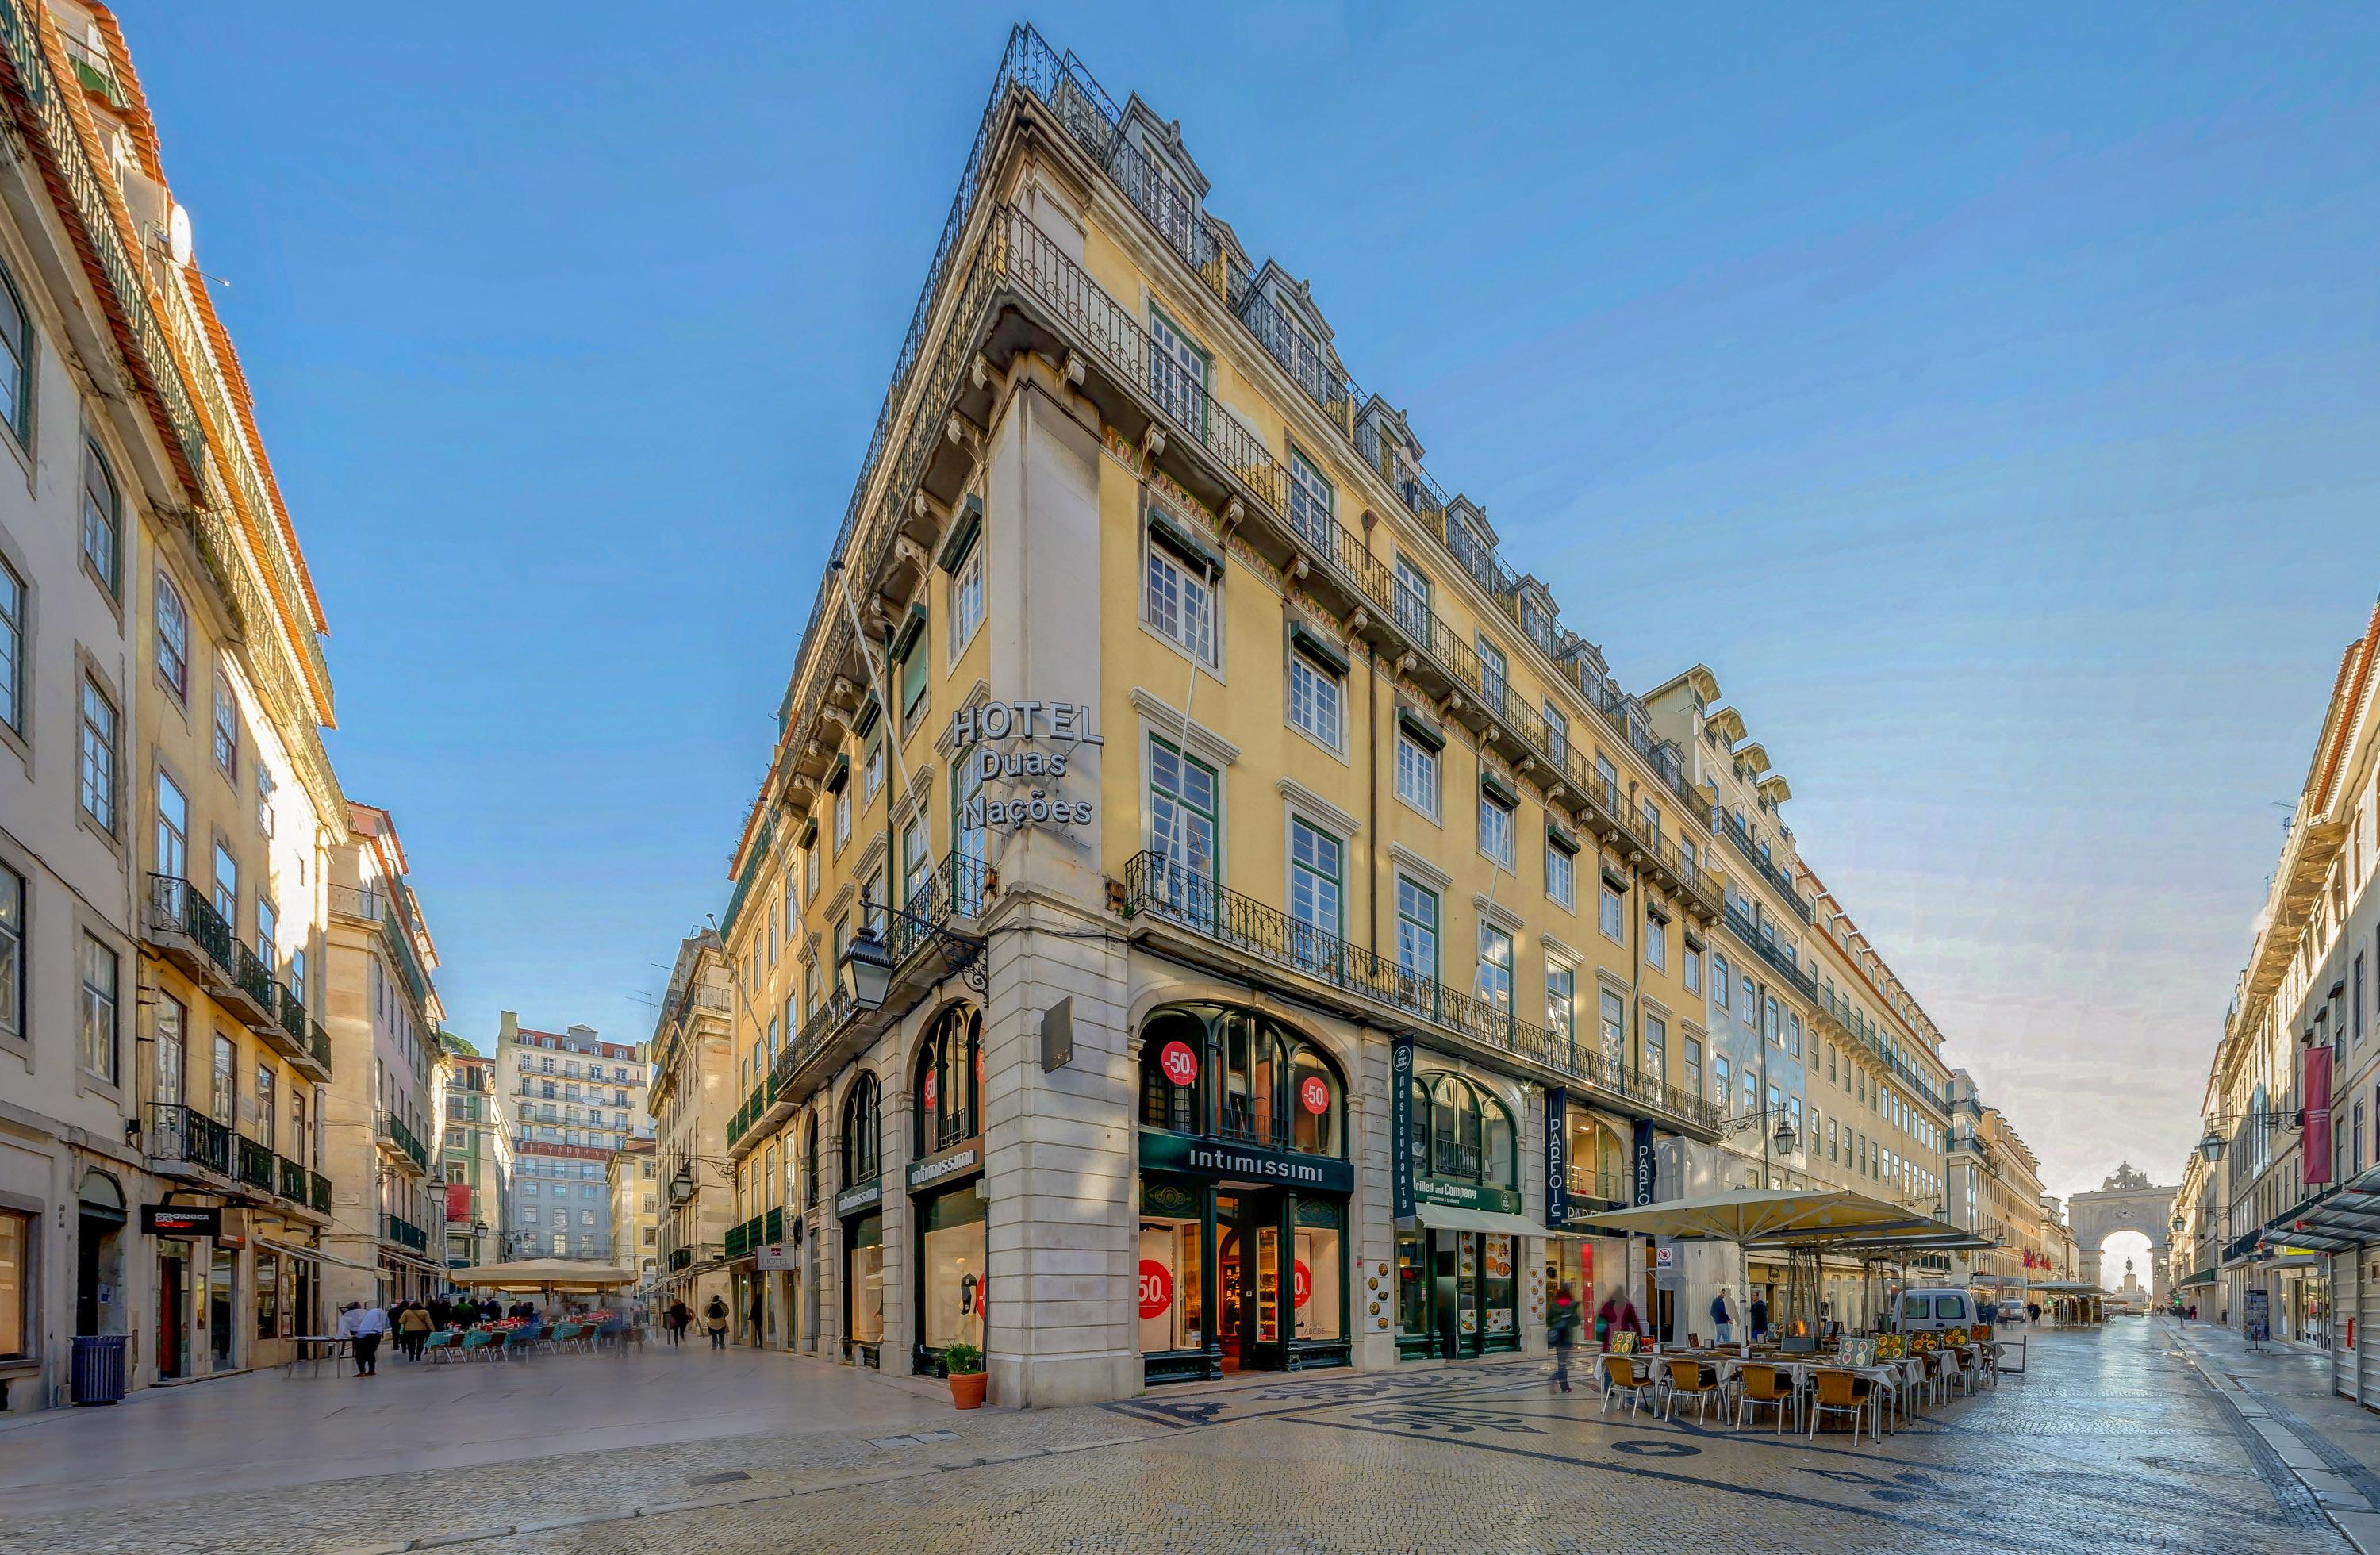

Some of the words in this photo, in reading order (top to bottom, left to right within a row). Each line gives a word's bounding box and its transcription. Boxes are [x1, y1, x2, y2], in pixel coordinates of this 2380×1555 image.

[953, 701, 1104, 747] HOTEL
[979, 749, 1067, 781] Duas
[962, 790, 1092, 830] Nações
[1399, 1075, 1407, 1208] Restaurante
[1190, 1150, 1322, 1181] intimissimi
[1549, 1119, 1562, 1218] PARFOIS
[1414, 1177, 1434, 1192] rilled
[1444, 1183, 1476, 1200] Company
